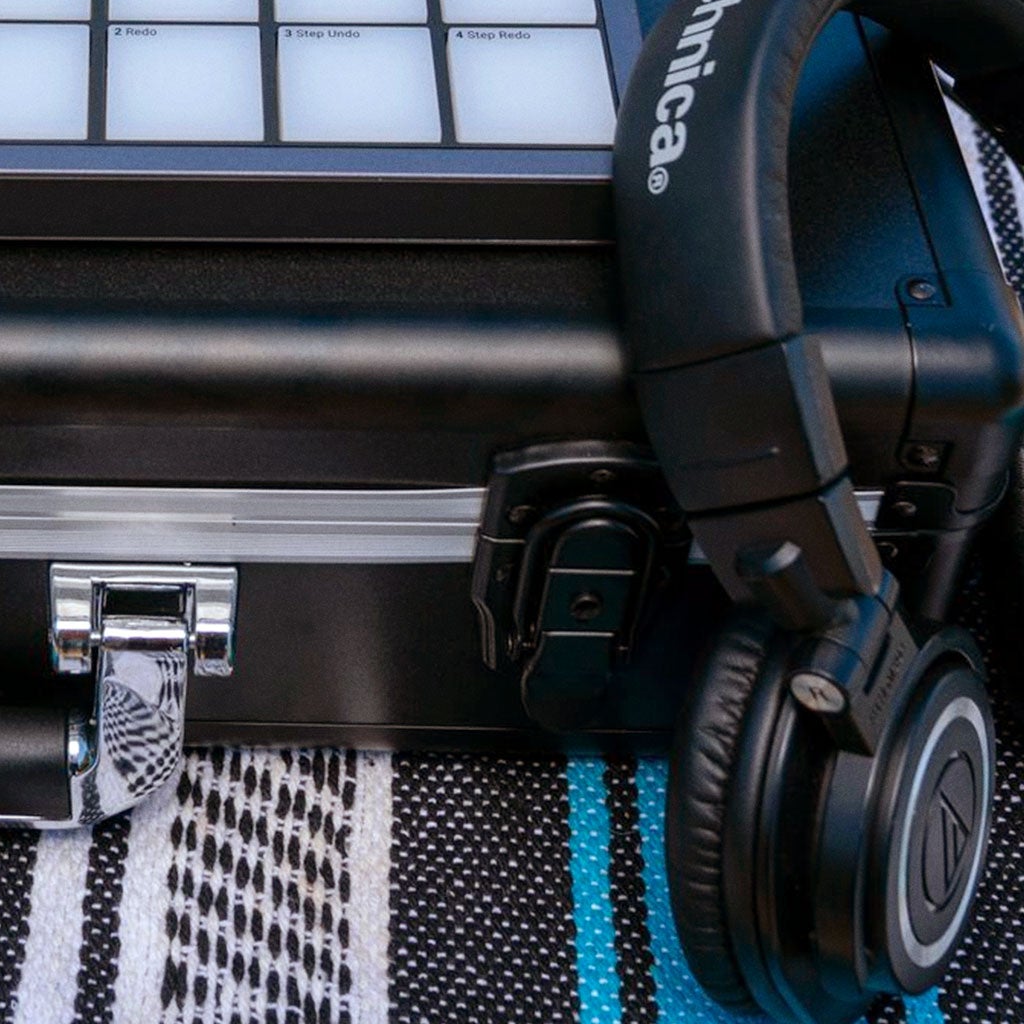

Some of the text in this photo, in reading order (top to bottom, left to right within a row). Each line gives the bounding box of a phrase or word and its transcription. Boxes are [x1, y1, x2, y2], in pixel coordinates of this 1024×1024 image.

[115, 27, 158, 36] 2 Redo
[285, 29, 360, 39] 3 Step Undo
[456, 30, 531, 40] 4 Step Redo
